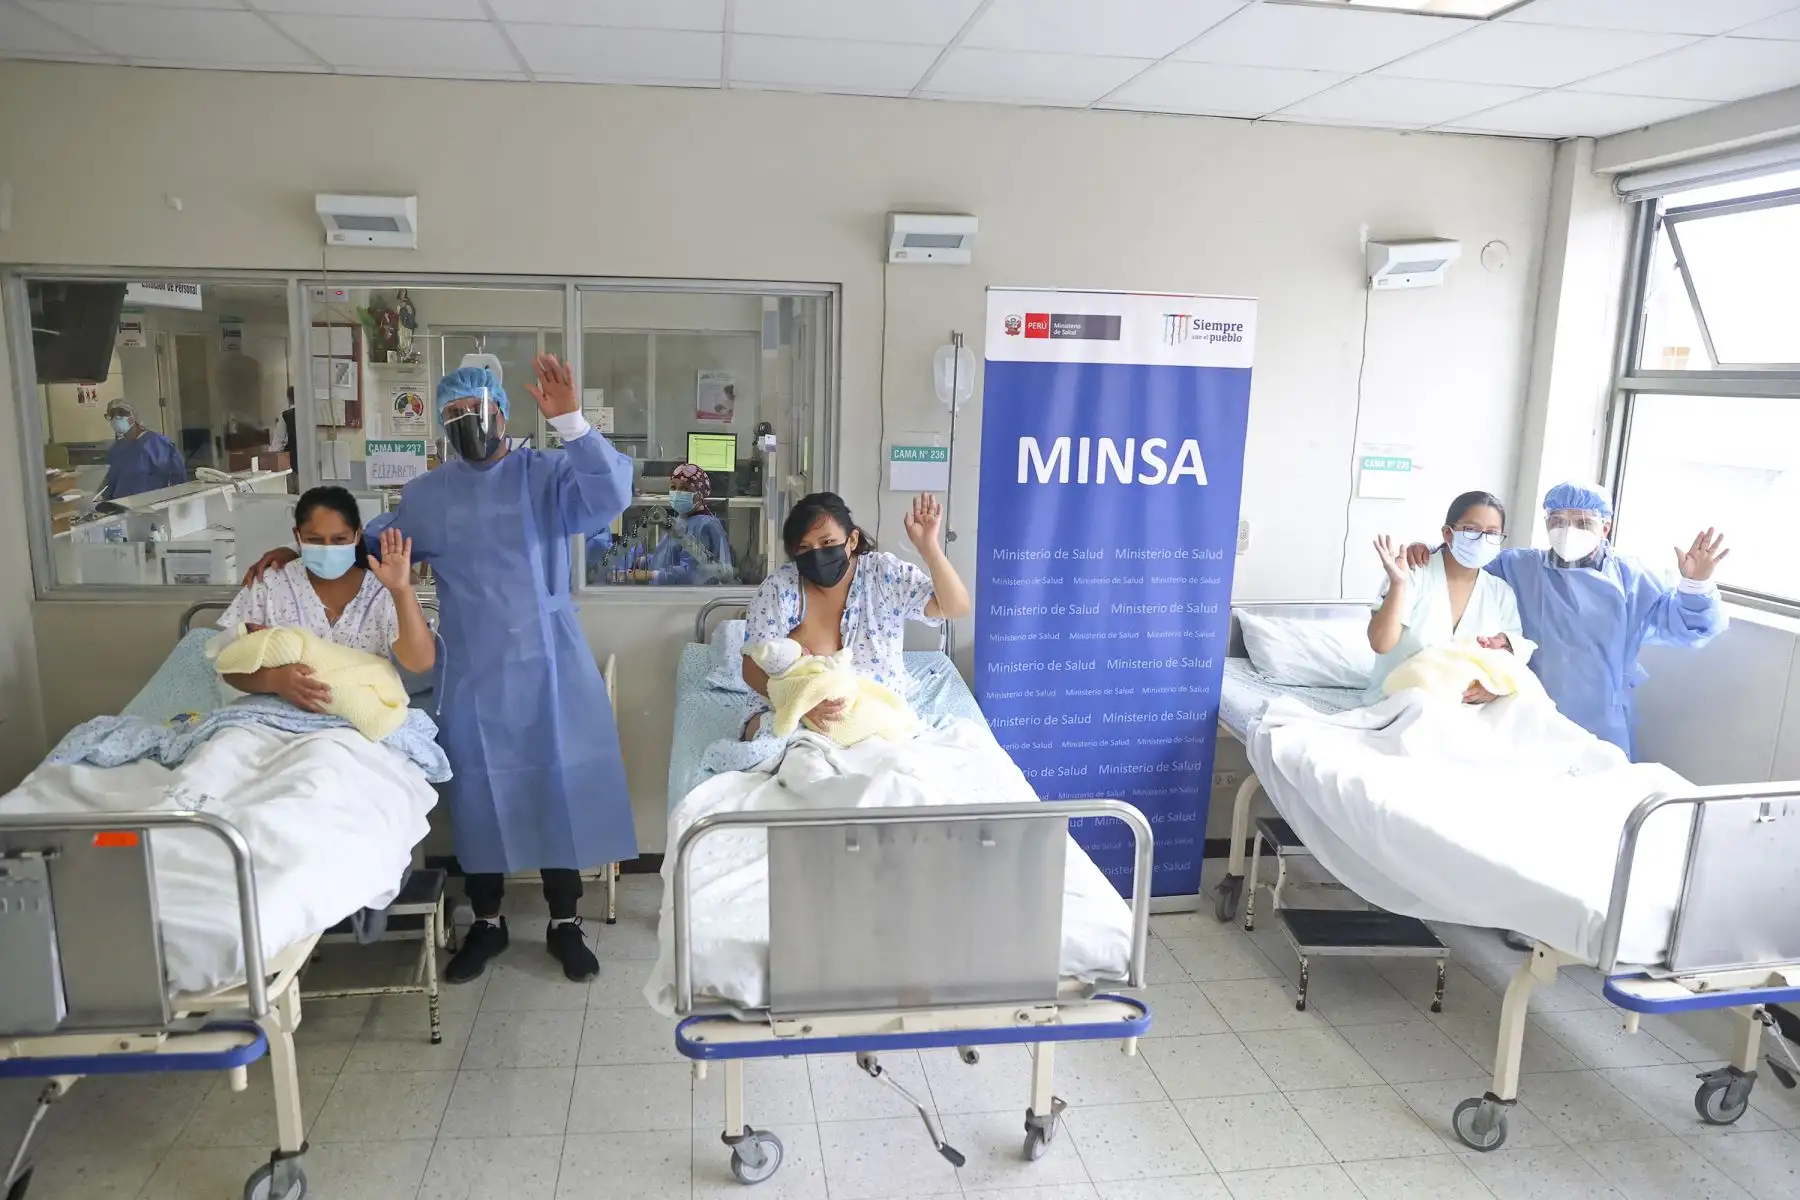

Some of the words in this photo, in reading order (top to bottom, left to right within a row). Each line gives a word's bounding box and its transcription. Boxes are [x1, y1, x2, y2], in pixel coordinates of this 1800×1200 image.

[1028, 320, 1047, 330] PERÚ
[1193, 319, 1243, 334] Siempre
[1210, 332, 1242, 344] pueblo
[368, 443, 392, 452] CAMA
[406, 444, 421, 453] 237
[894, 450, 917, 458] CAMA
[1017, 436, 1208, 486] MINSA
[993, 548, 1051, 560] Ministerio
[1055, 548, 1069, 559] de
[1073, 548, 1104, 560] Salud
[1115, 548, 1171, 560] Ministerio
[1174, 548, 1188, 559] de
[1192, 549, 1223, 560] Salud
[992, 577, 1030, 586] Ministerio
[1042, 577, 1063, 585] Salud
[1073, 576, 1110, 585] Ministerio
[1151, 576, 1187, 584] Ministerio
[1189, 576, 1198, 584] de
[990, 604, 1048, 616] Ministerio
[1051, 604, 1065, 615] de
[1069, 604, 1100, 615] Salud
[1111, 603, 1167, 614] Ministerio
[1170, 603, 1183, 614] de
[1187, 603, 1218, 614] Salud
[989, 632, 1027, 642] Ministerio
[1039, 632, 1060, 640] Salud
[1070, 632, 1107, 640] Ministerio
[1118, 631, 1139, 639] Salud
[1147, 630, 1182, 639] Ministerio
[988, 660, 1044, 673] Ministerio
[1048, 660, 1062, 671] de
[1065, 660, 1096, 670] Salud
[1107, 658, 1162, 669] Ministerio
[1166, 657, 1178, 668] de
[1181, 658, 1212, 668] Salud
[986, 689, 1023, 699] Ministerio
[1035, 689, 1056, 697] Salud
[1114, 687, 1134, 695] Salud
[1142, 686, 1177, 694] Ministerio
[1044, 715, 1059, 726] de
[1062, 713, 1091, 724] Salud
[1102, 712, 1158, 724] Ministerio
[1161, 710, 1174, 722] de
[1176, 710, 1207, 721] Salud
[1032, 741, 1053, 749] Salud
[1062, 740, 1098, 748] Ministerio
[1137, 738, 1172, 746] Ministerio
[1041, 767, 1055, 777] de
[1057, 765, 1087, 777] Salud
[1099, 763, 1154, 775] Ministerio
[1156, 762, 1170, 772] de
[1172, 760, 1202, 772] Salud
[1152, 812, 1164, 823] de
[1168, 811, 1196, 822] Salud
[1164, 861, 1191, 872] Salud
